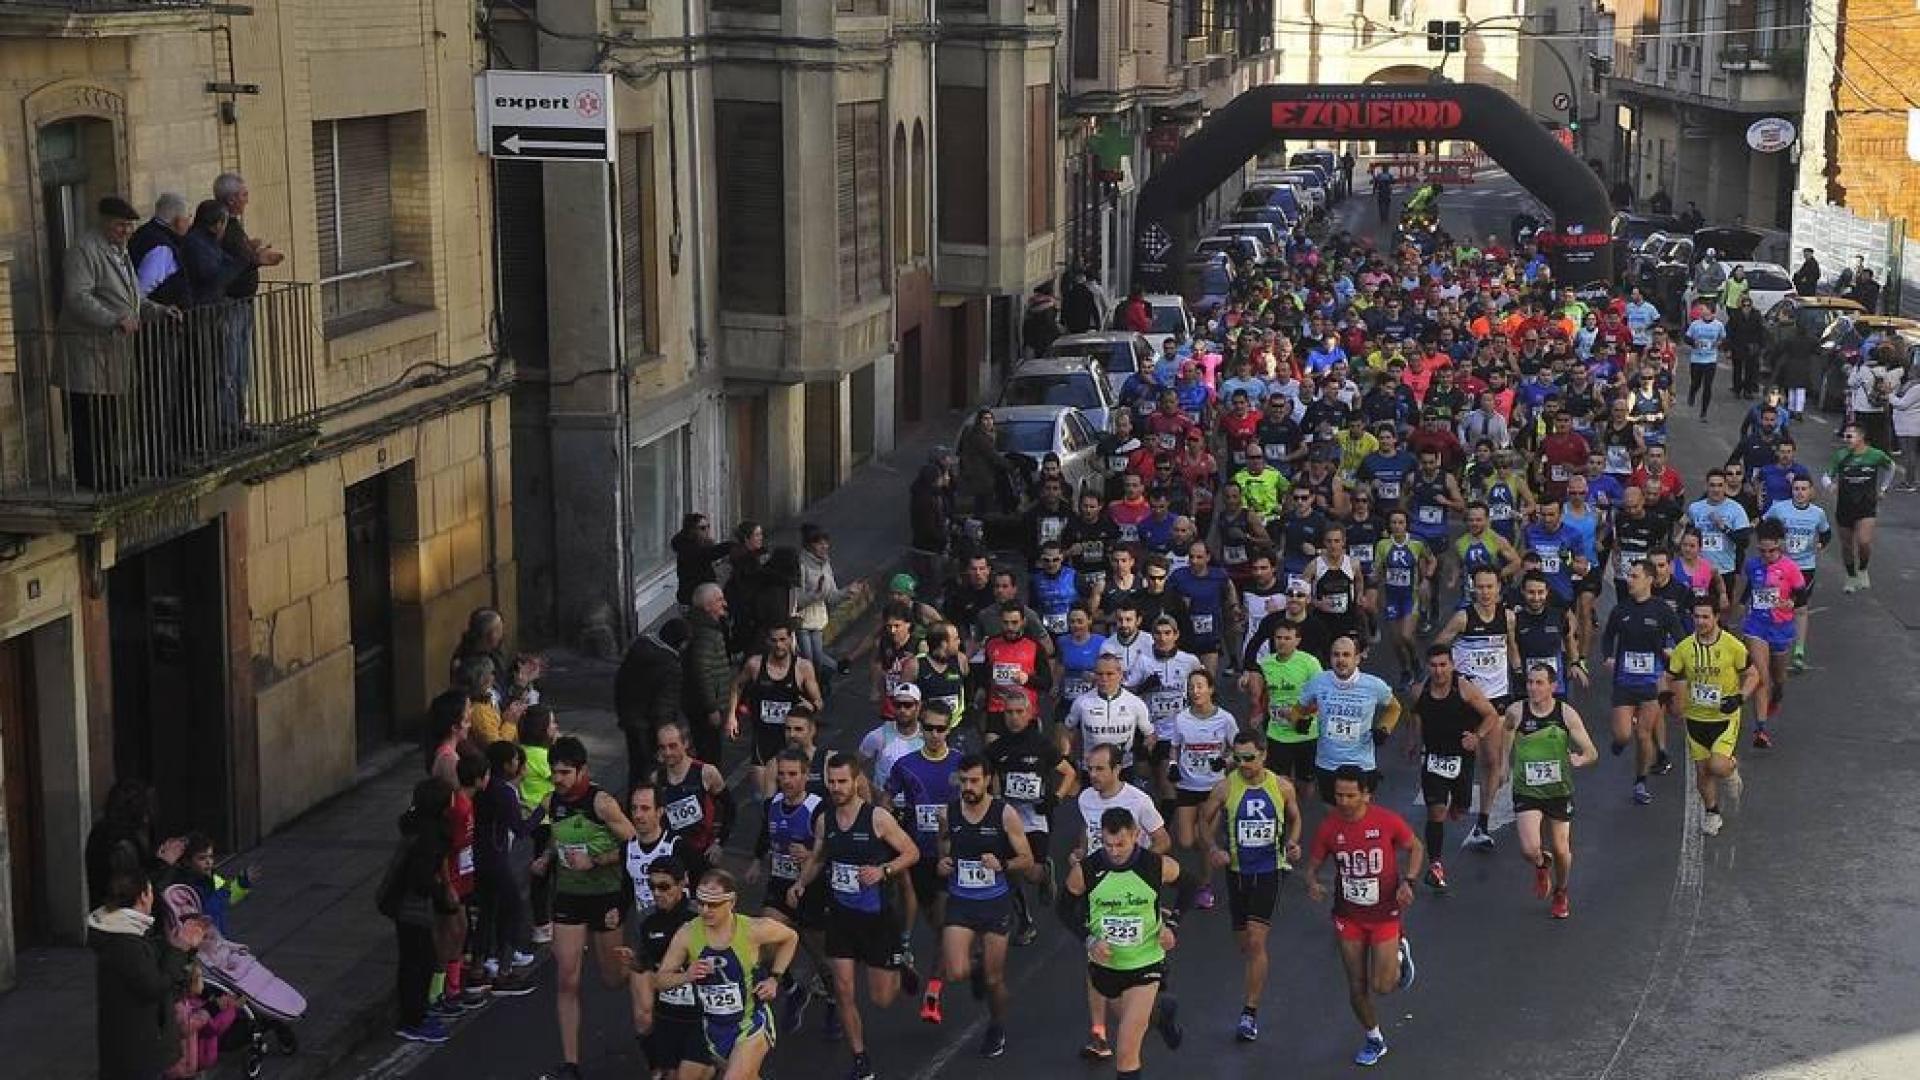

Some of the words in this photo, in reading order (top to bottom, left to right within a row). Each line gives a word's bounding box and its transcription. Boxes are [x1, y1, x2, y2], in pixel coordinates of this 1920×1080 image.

[495, 95, 570, 110] expert
[1271, 101, 1462, 131] EZQUERRO
[1246, 798, 1267, 820] R
[1245, 827, 1271, 840] 142
[1336, 848, 1384, 876] 360
[1107, 926, 1138, 939] 223
[705, 993, 737, 1007] 125
